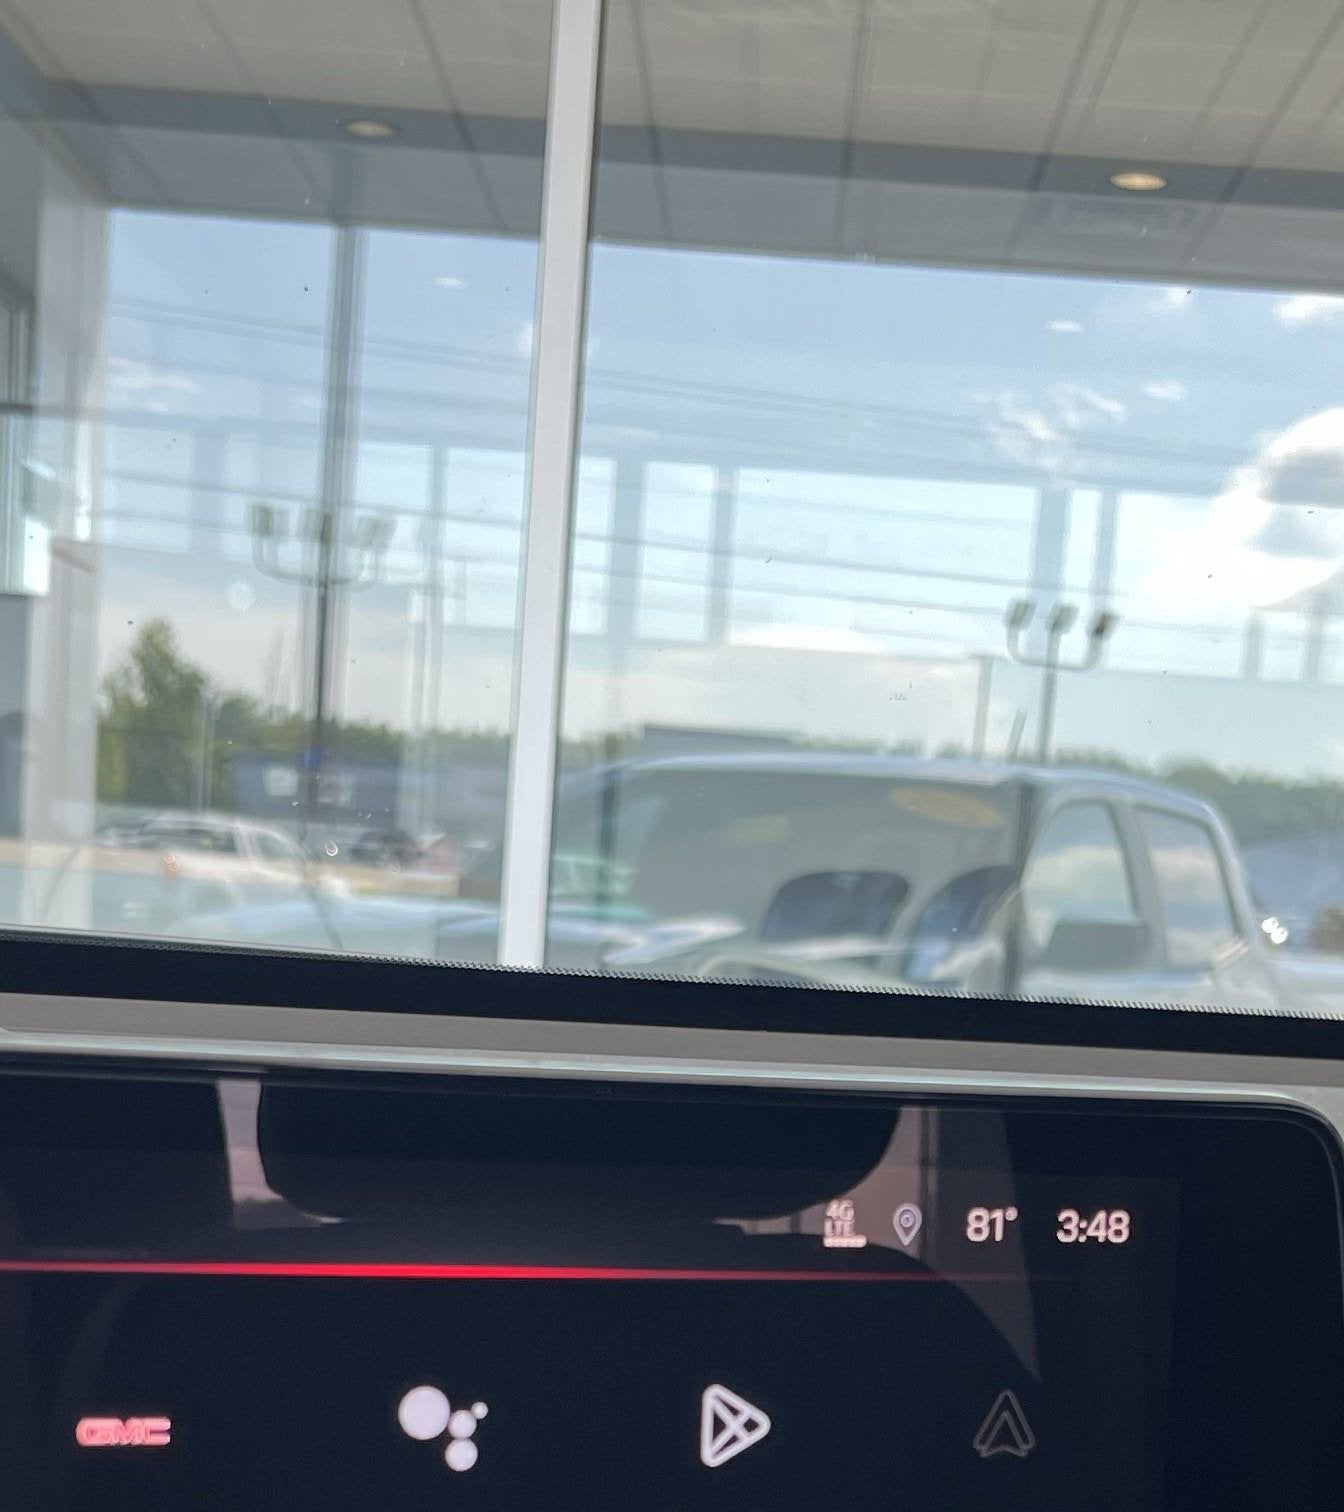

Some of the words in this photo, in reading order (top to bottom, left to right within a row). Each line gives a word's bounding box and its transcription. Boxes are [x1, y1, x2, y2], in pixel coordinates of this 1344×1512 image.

[826, 1199, 855, 1220] 4G
[966, 1206, 1018, 1243] 81°
[824, 1219, 855, 1237] LTE
[1057, 1209, 1130, 1244] 3:48
[75, 1416, 171, 1446] GMC
